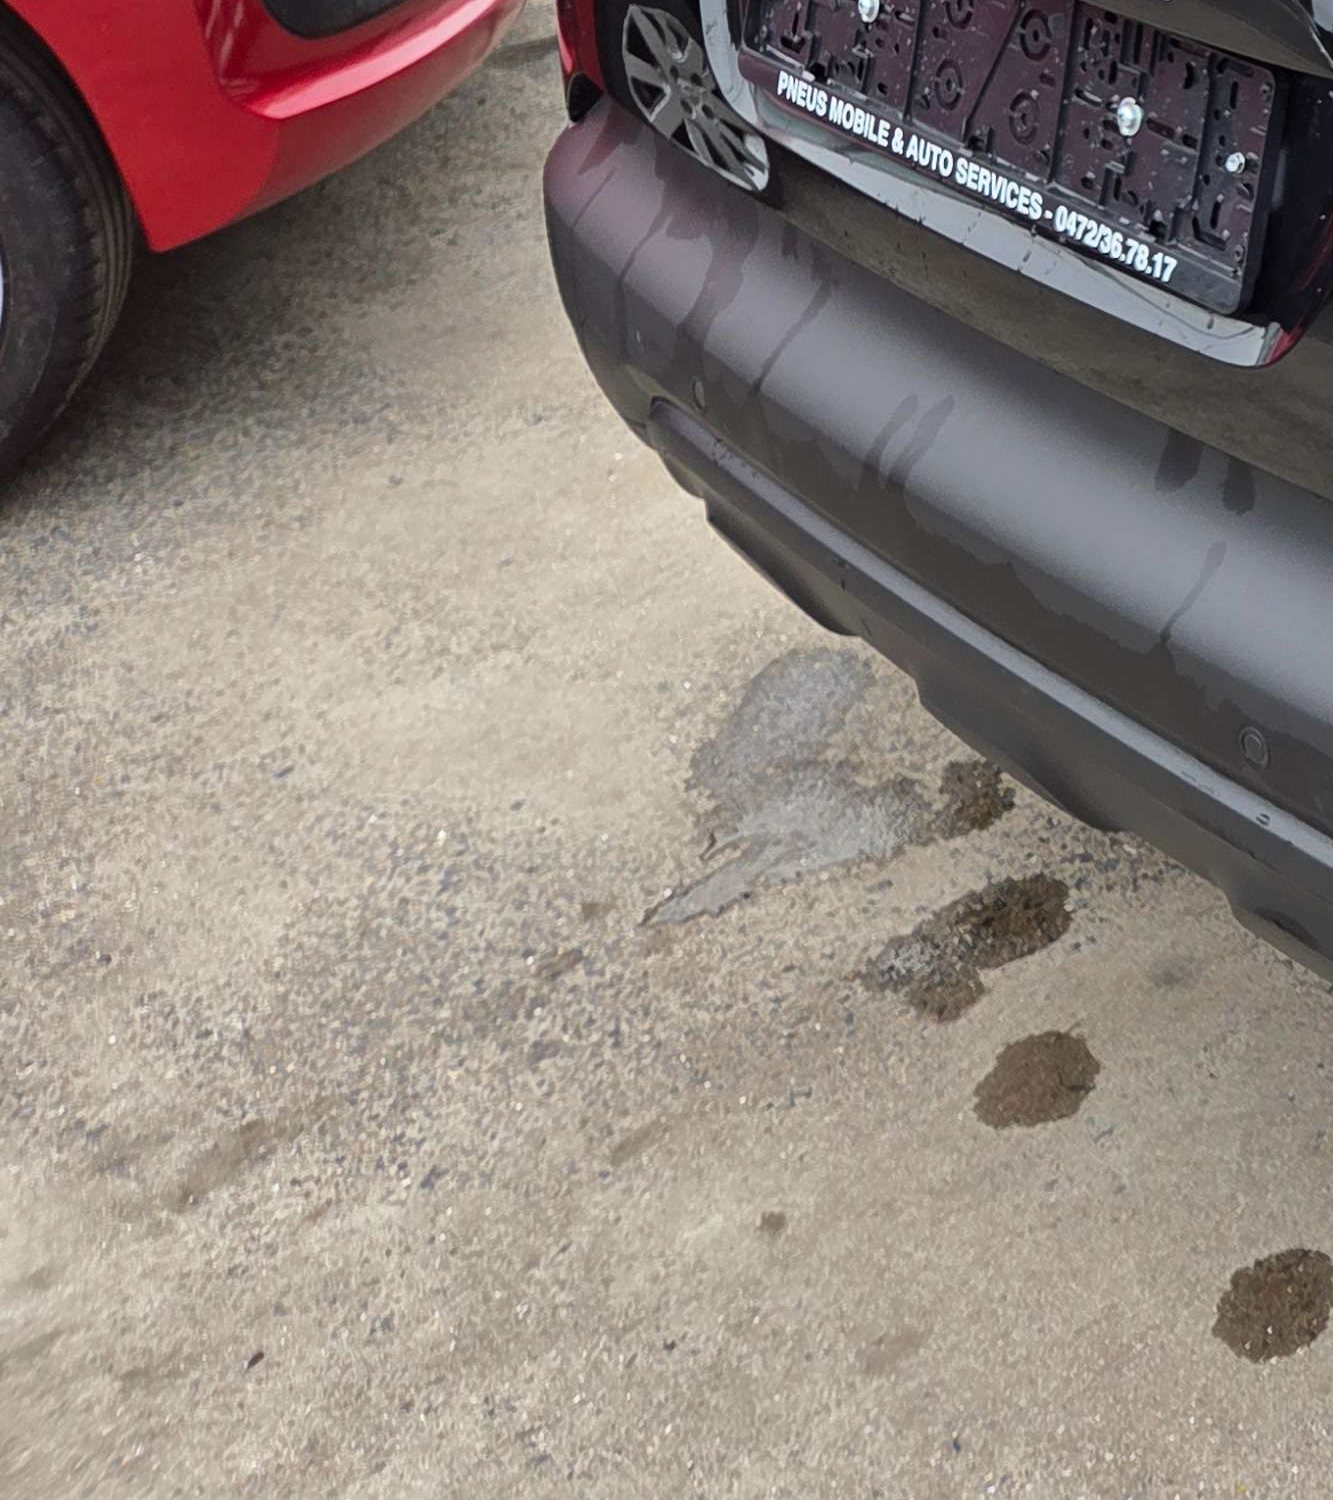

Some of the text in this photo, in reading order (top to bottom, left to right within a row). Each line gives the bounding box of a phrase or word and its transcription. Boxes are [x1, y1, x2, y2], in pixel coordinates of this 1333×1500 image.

[777, 70, 828, 117] PNEUS
[828, 96, 891, 147] MOBILE
[891, 126, 904, 155] &
[905, 134, 954, 178] AUTO
[955, 156, 1043, 220] SERVICES
[1054, 204, 1178, 282] 0472/36.78.17
